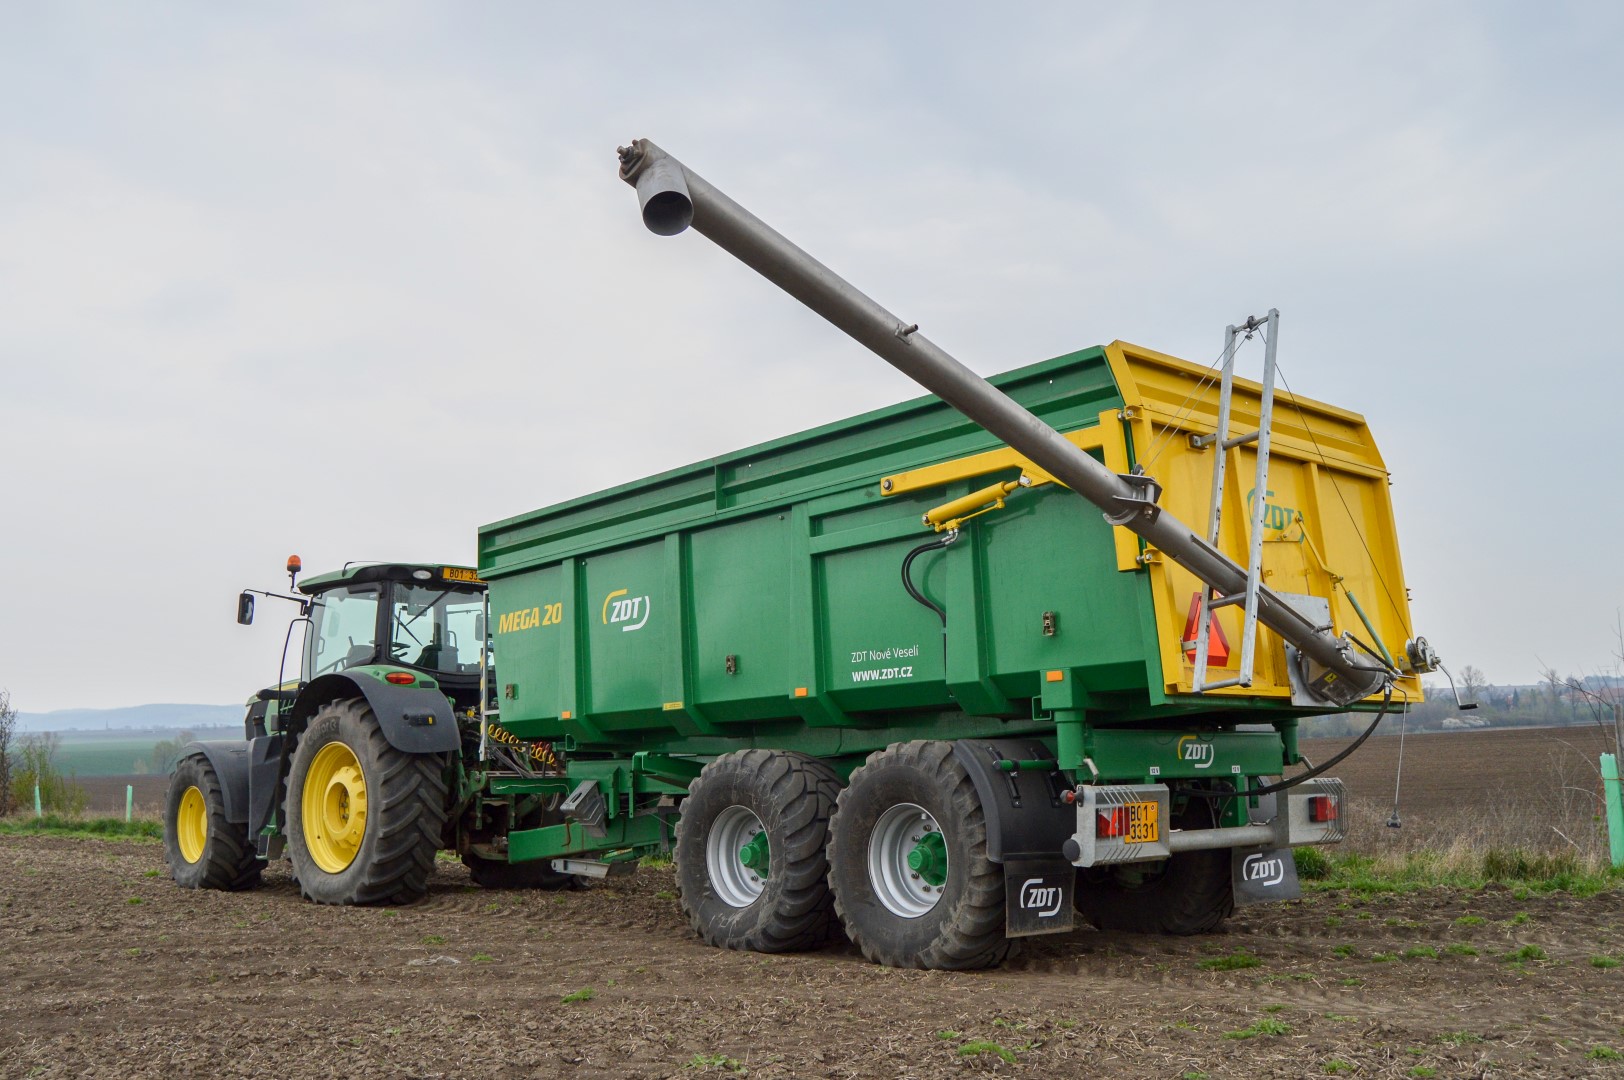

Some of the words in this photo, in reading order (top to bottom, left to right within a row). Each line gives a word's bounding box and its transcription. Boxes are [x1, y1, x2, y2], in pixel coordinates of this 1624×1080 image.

[498, 607, 540, 634] MEGA
[542, 602, 563, 626] 20
[610, 597, 642, 623] ZDT
[851, 651, 867, 663] ZDT
[869, 648, 891, 661] Nové
[893, 644, 919, 658] Veselí
[1184, 743, 1208, 760] ZDT
[1130, 823, 1154, 840] 3331
[1250, 860, 1276, 880] ZDT
[1027, 887, 1056, 908] ZDT
